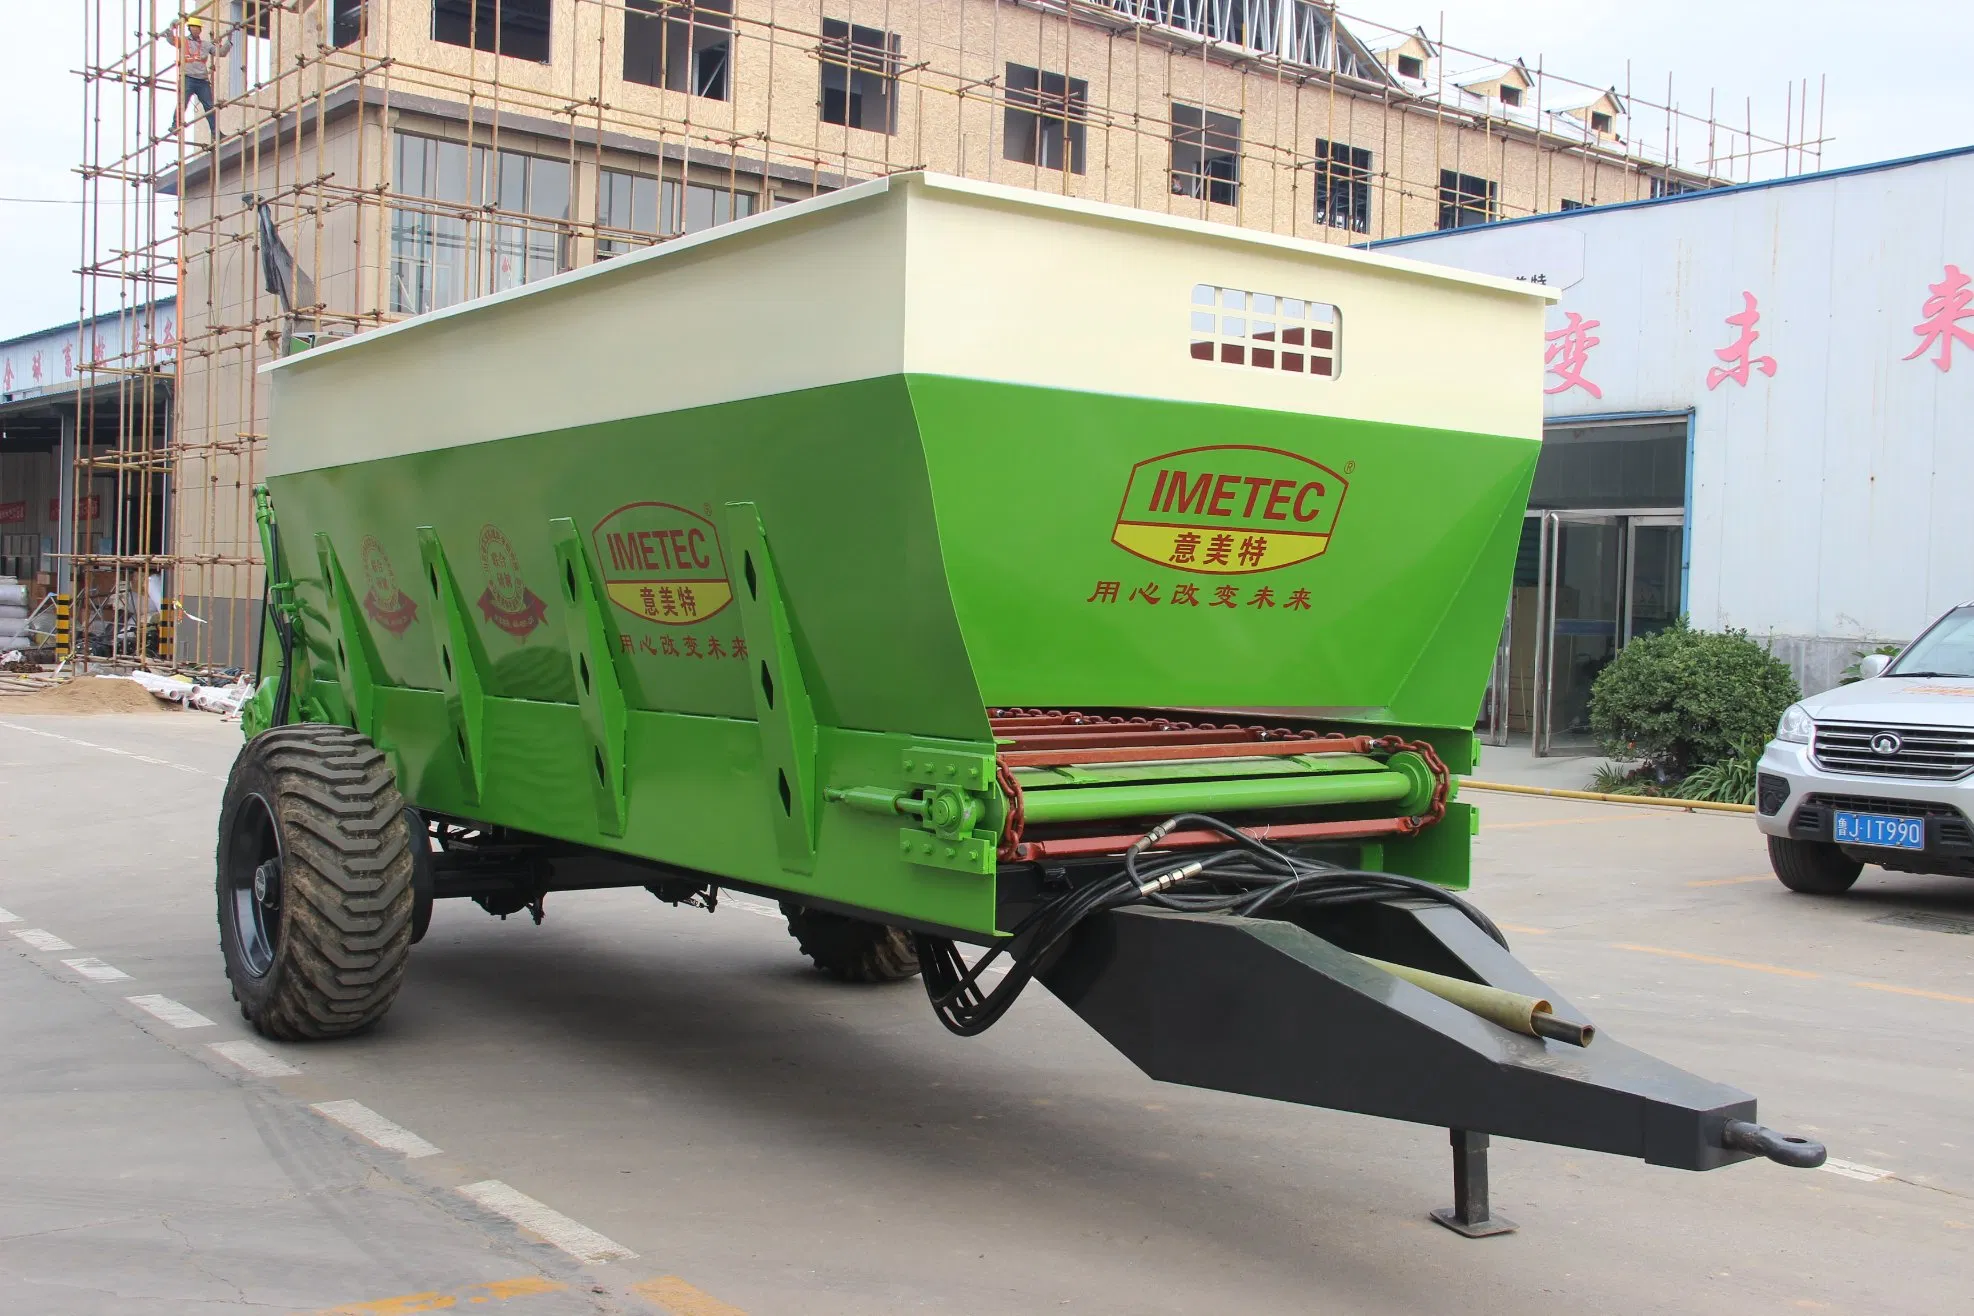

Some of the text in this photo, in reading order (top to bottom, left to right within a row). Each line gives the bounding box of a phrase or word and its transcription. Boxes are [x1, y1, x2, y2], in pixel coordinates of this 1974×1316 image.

[1148, 469, 1326, 523] IMETEC
[606, 527, 710, 571] IMETEC
[1169, 531, 1268, 567] 意美特
[639, 586, 697, 617] 意美特
[1086, 580, 1313, 612] 用心改变未来
[619, 634, 749, 661] 用心改变未来
